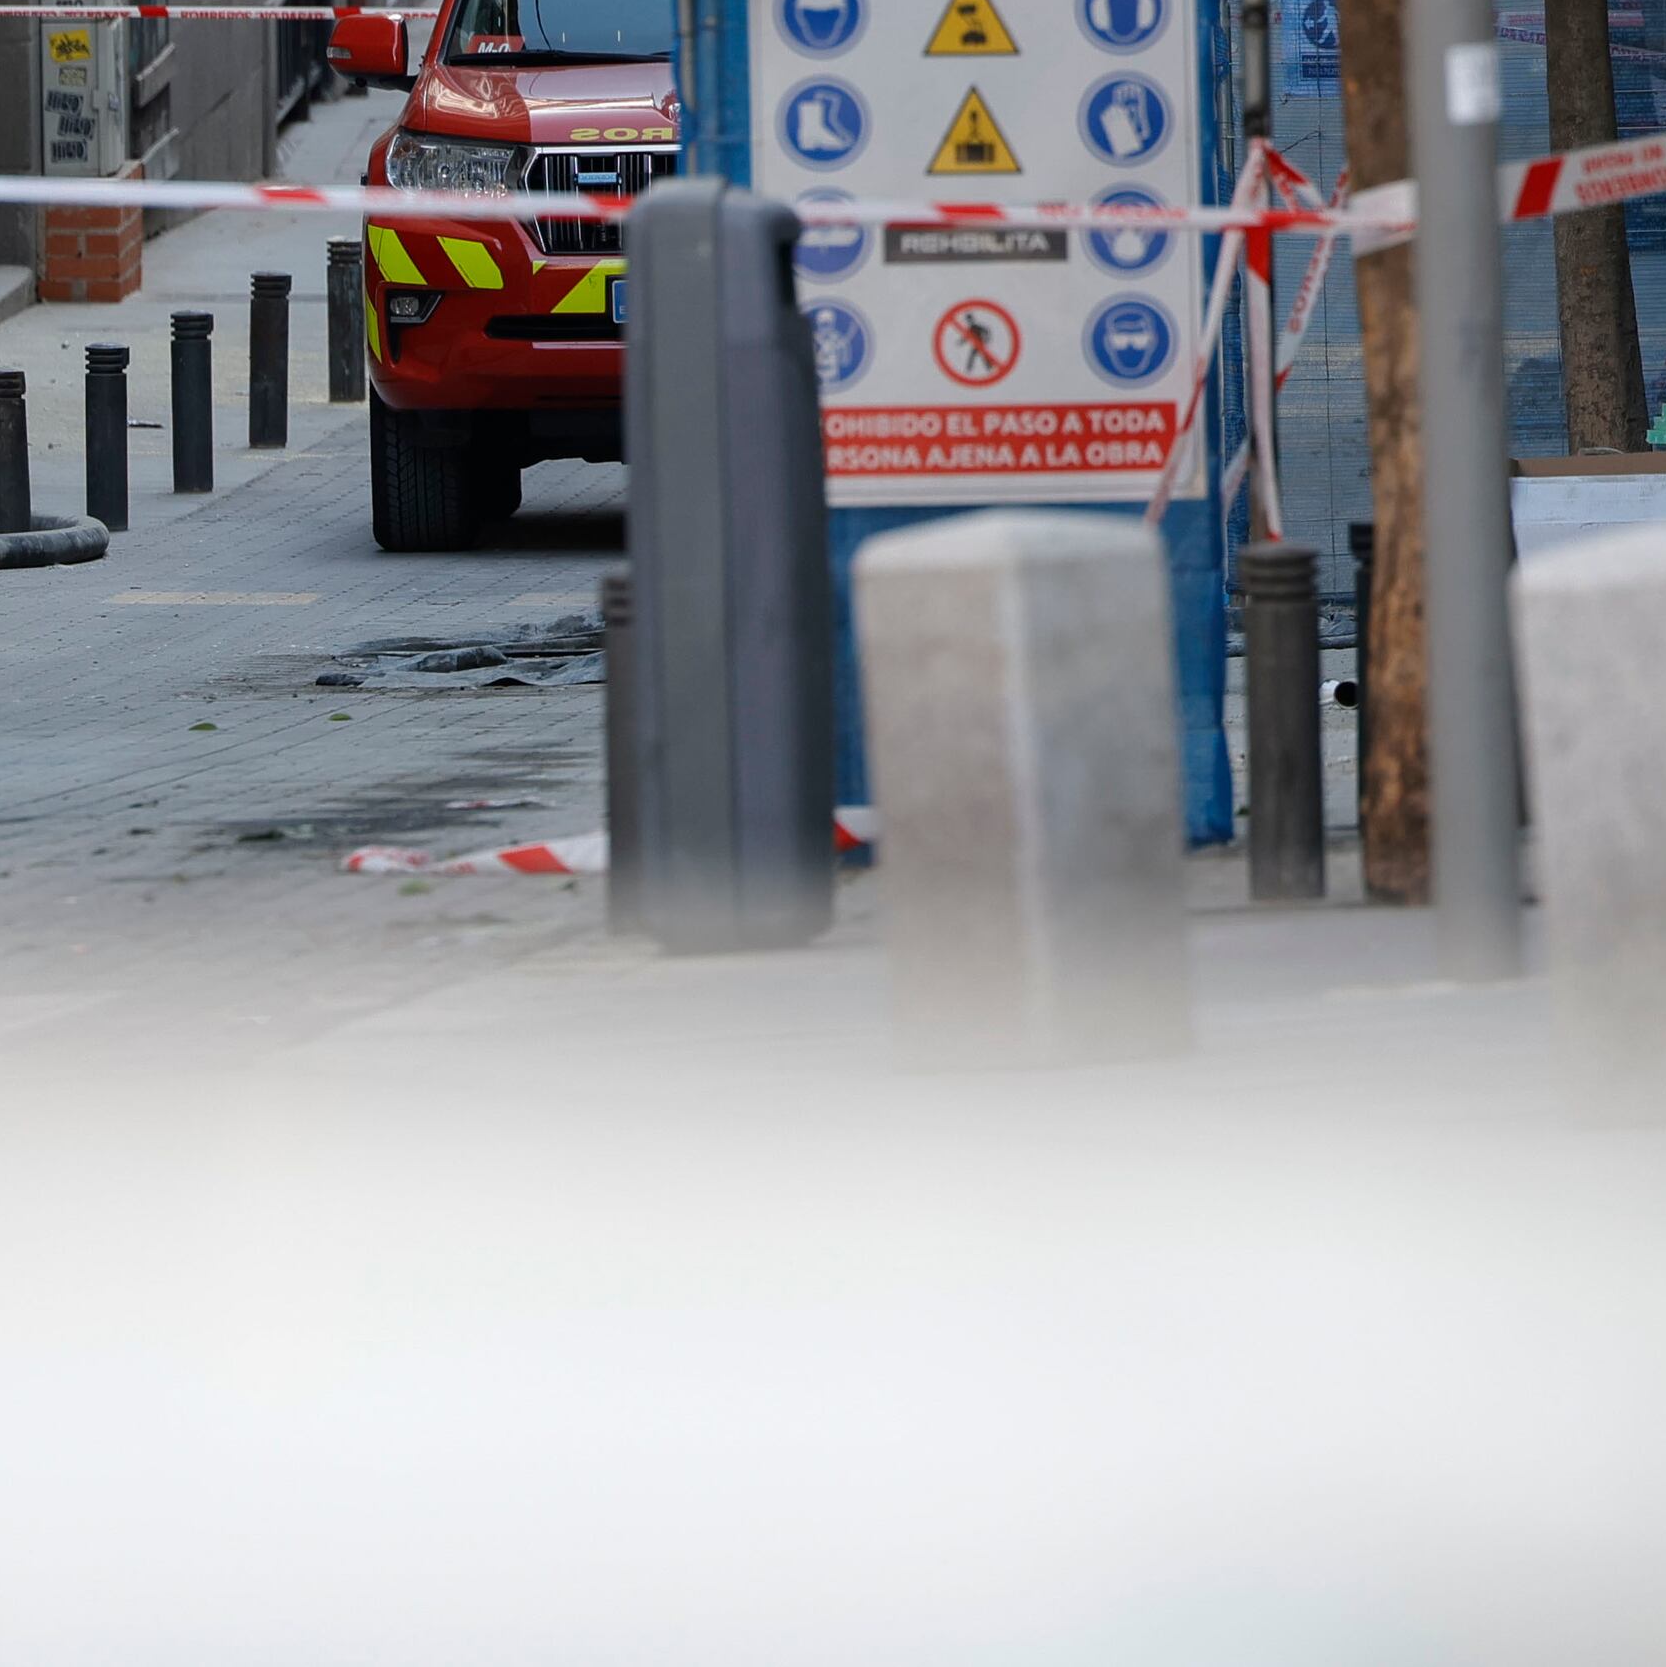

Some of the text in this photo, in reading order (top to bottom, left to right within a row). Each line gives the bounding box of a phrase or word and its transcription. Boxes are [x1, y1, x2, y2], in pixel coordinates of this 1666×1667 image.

[825, 407, 1167, 439] OHIBIDO EL PASO A TODA
[826, 439, 1164, 471] RSONA AJENA A LA OBRA
